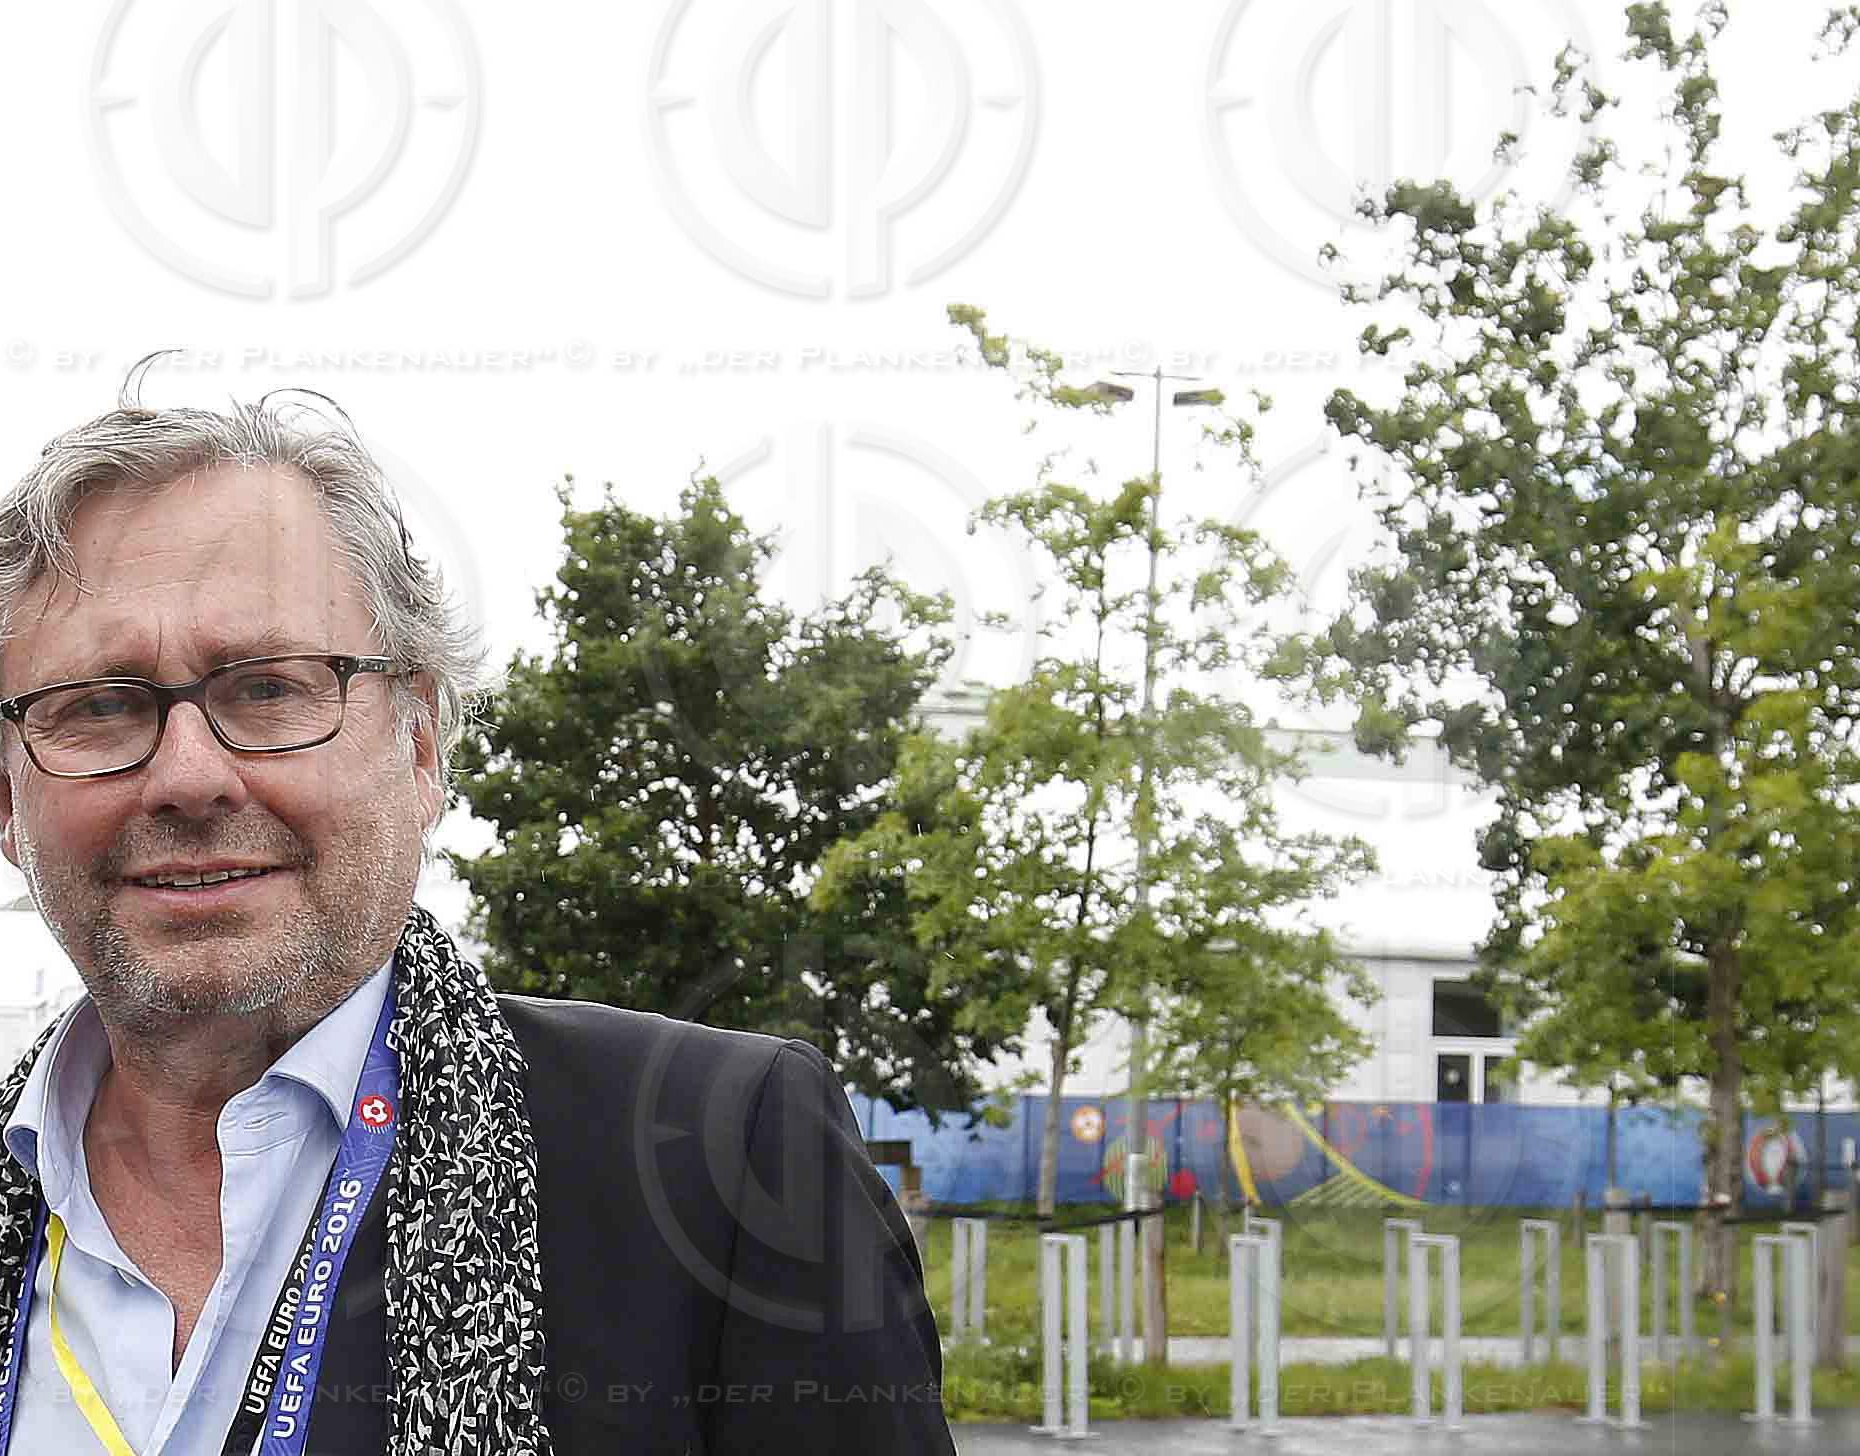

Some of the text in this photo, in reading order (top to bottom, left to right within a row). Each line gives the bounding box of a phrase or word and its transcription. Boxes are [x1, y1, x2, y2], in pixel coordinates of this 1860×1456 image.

[244, 1353, 283, 1415] UEFA
[268, 1286, 303, 1354] EURO
[272, 1350, 313, 1440] UEFA
[296, 1260, 335, 1348] EURO
